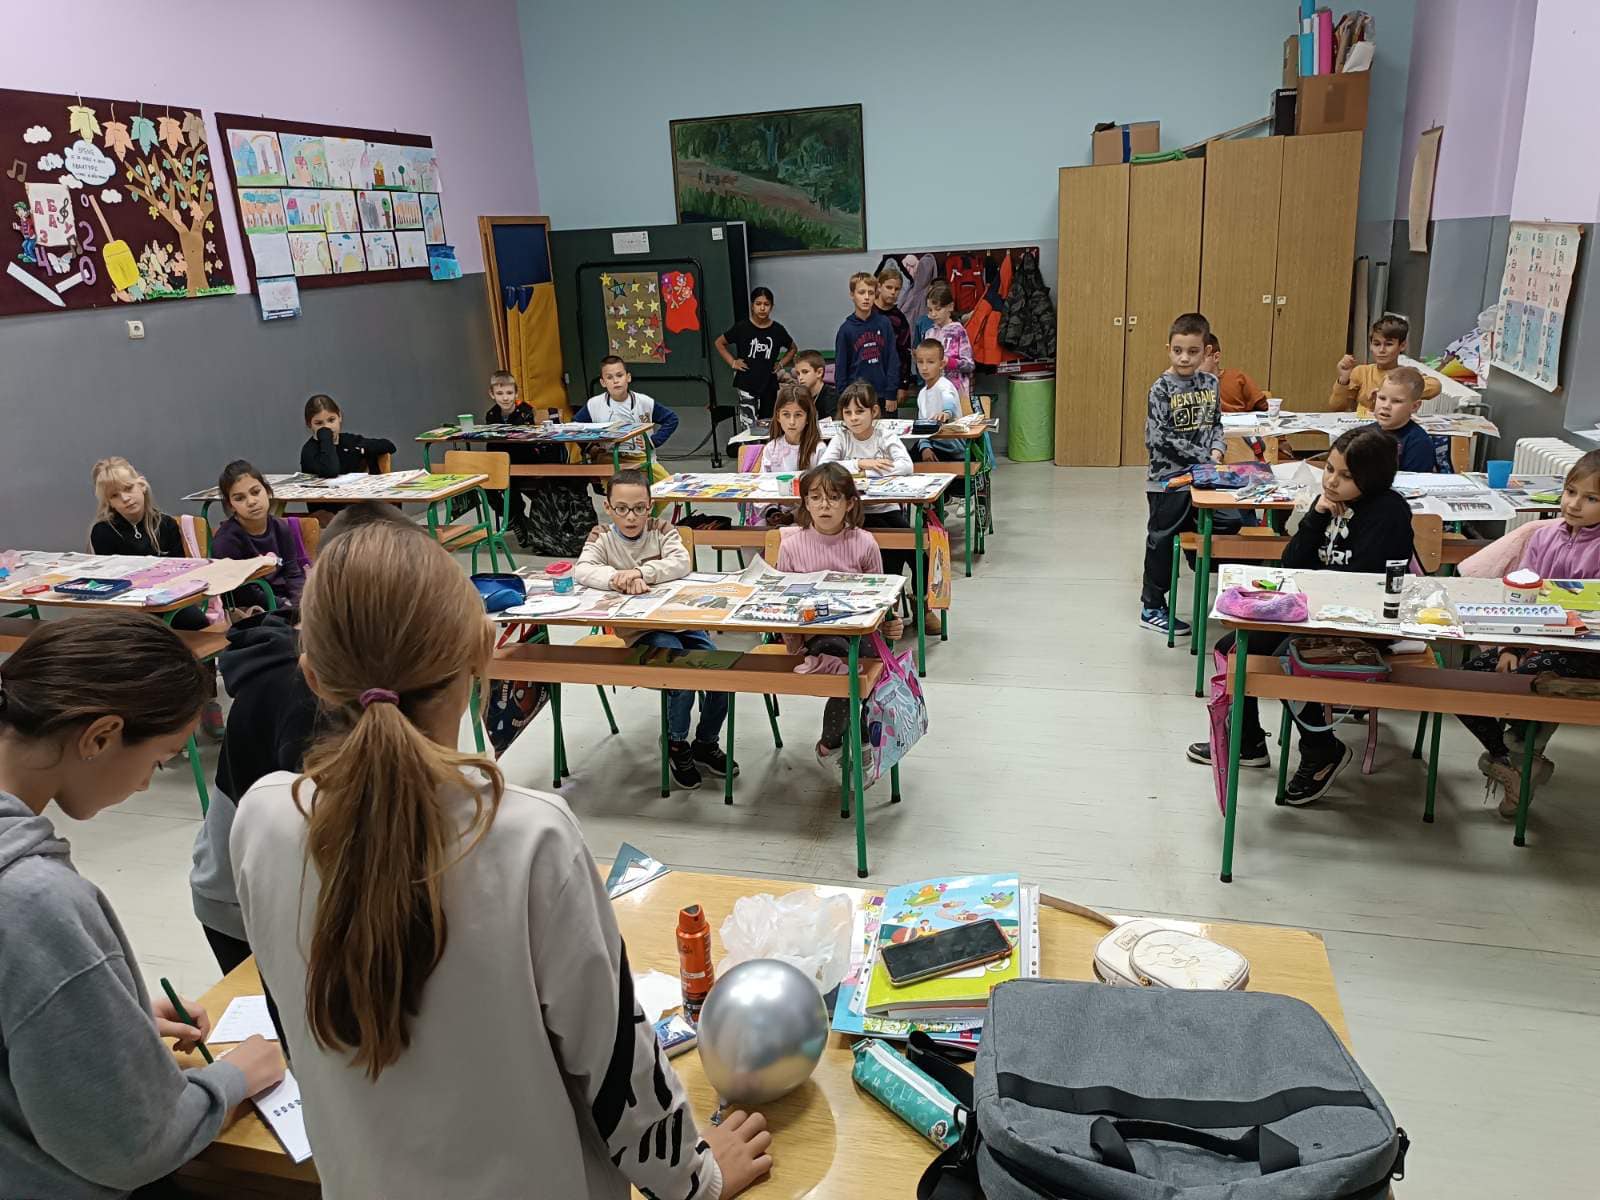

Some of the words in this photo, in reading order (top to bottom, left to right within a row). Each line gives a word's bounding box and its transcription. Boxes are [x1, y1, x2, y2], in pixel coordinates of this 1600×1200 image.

[79, 221, 97, 252] 2
[34, 246, 53, 277] 4
[1170, 392, 1194, 409] NEXT
